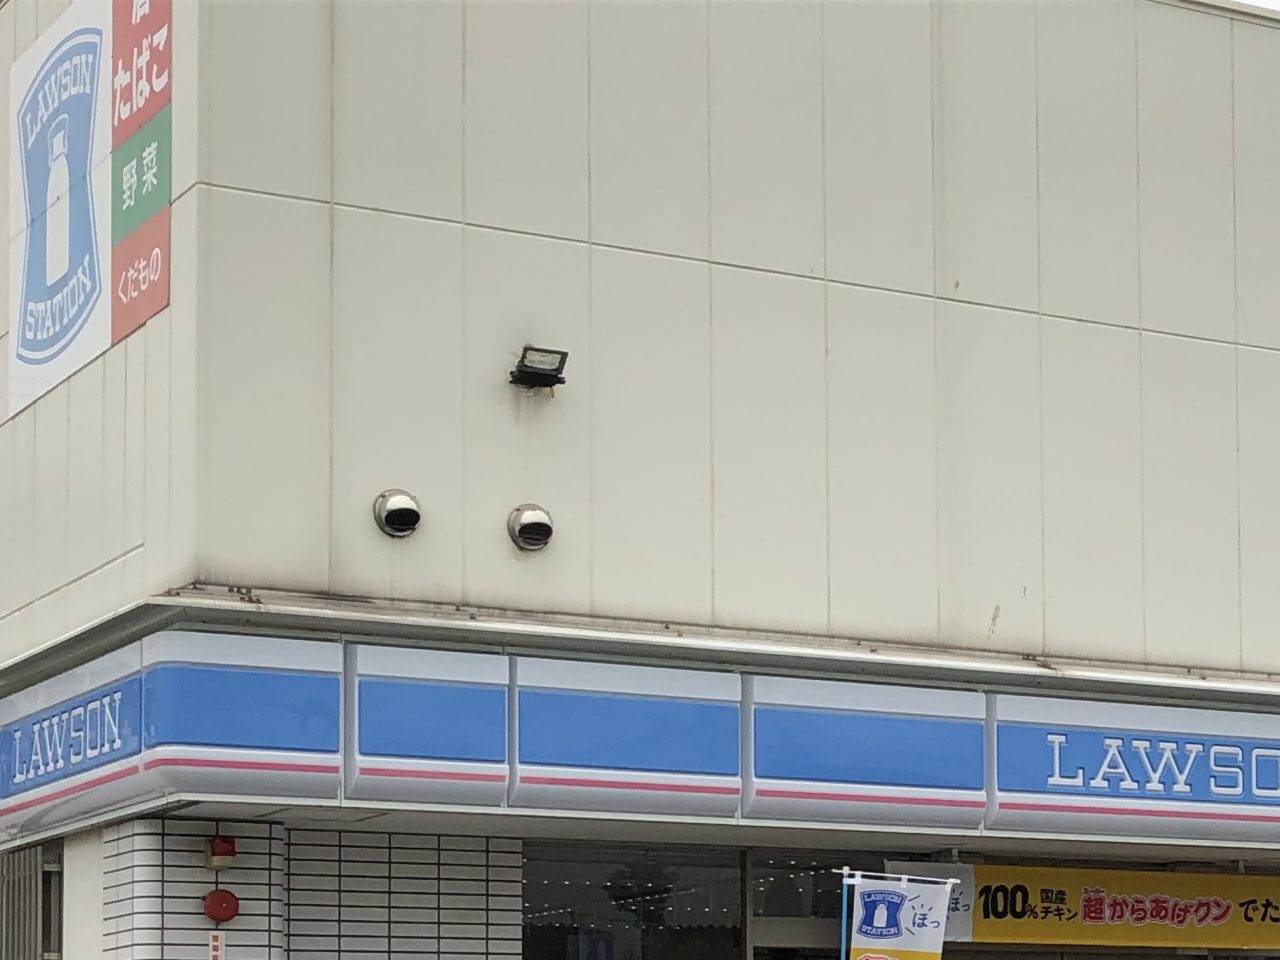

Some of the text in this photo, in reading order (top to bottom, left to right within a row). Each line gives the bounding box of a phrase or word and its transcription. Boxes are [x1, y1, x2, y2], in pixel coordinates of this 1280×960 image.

[26, 54, 93, 149] LAWSON
[113, 22, 168, 127] たばこ
[122, 142, 158, 211] 野菜
[25, 254, 91, 340] STATION
[118, 247, 161, 304] くだもの
[13, 691, 122, 784] LAWSON
[978, 884, 1068, 920] 100% 国産
[1040, 906, 1079, 921] チキン
